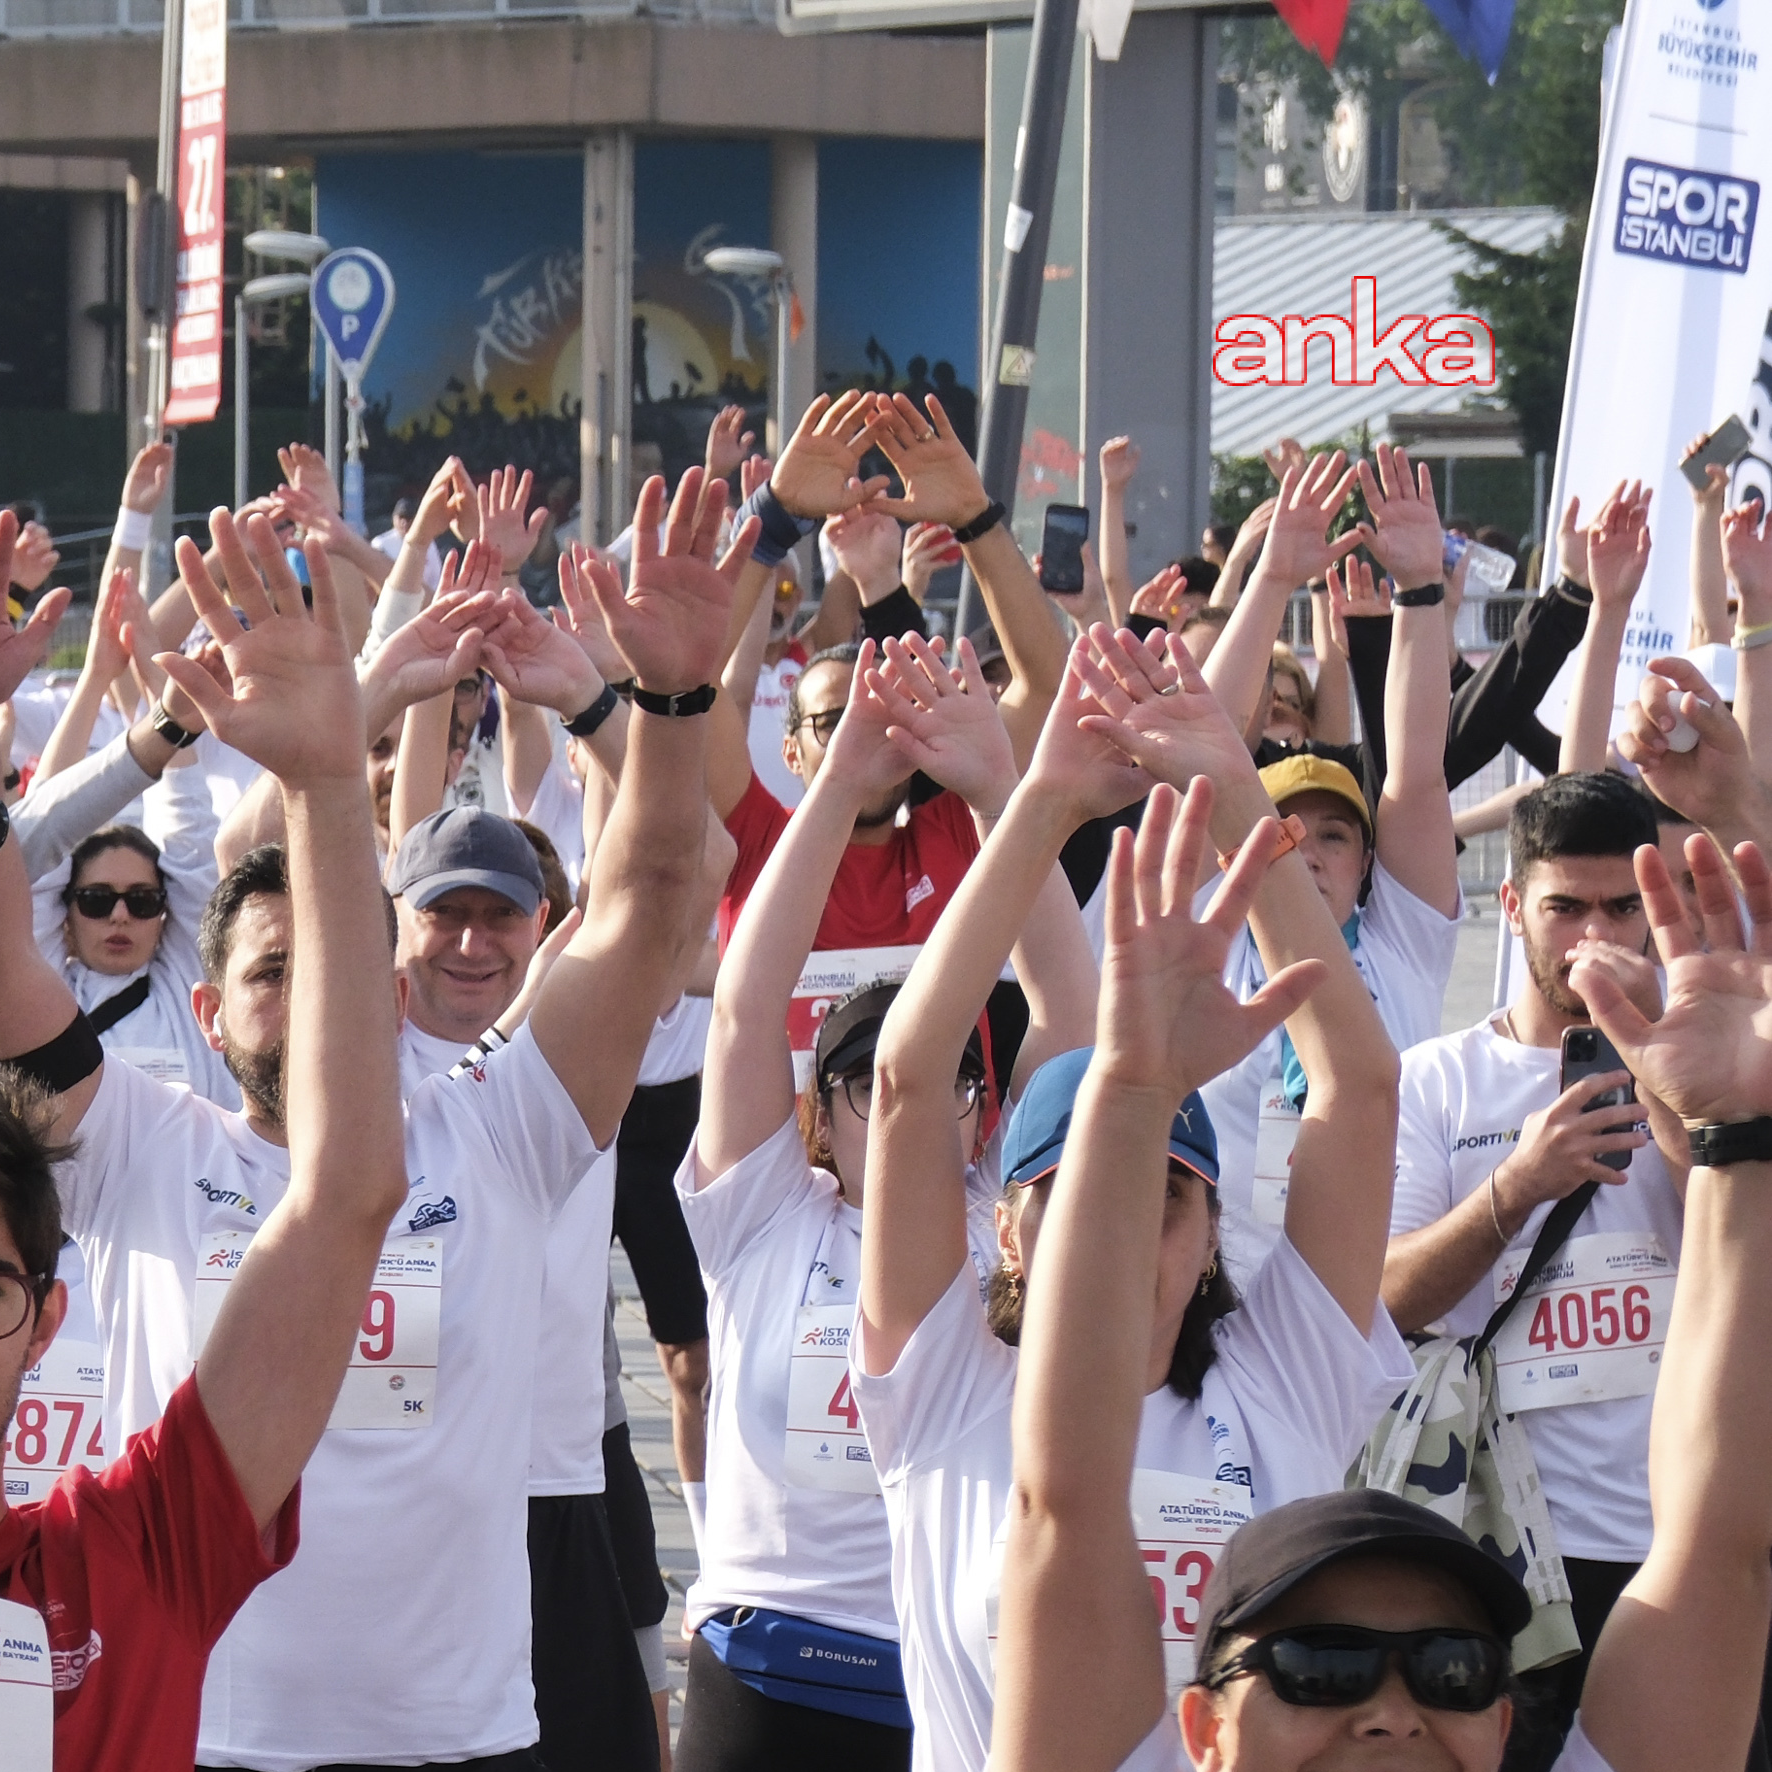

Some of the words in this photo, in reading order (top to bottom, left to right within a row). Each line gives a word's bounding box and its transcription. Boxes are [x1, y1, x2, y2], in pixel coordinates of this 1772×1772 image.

[1657, 33, 1759, 71] BÜYÜKŞEHİR
[1625, 165, 1750, 235] SPOR
[341, 315, 360, 341] P
[193, 1177, 258, 1216] SPORTIVE
[360, 1290, 396, 1361] 9
[1528, 1284, 1651, 1353] 4056
[403, 1400, 423, 1412] 5K
[827, 1367, 860, 1429] 4
[6, 1398, 105, 1467] 874
[1158, 1503, 1222, 1517] ATATÜRK'Ü
[3, 1637, 44, 1655] ANMA
[816, 1648, 878, 1668] BORUSAN
